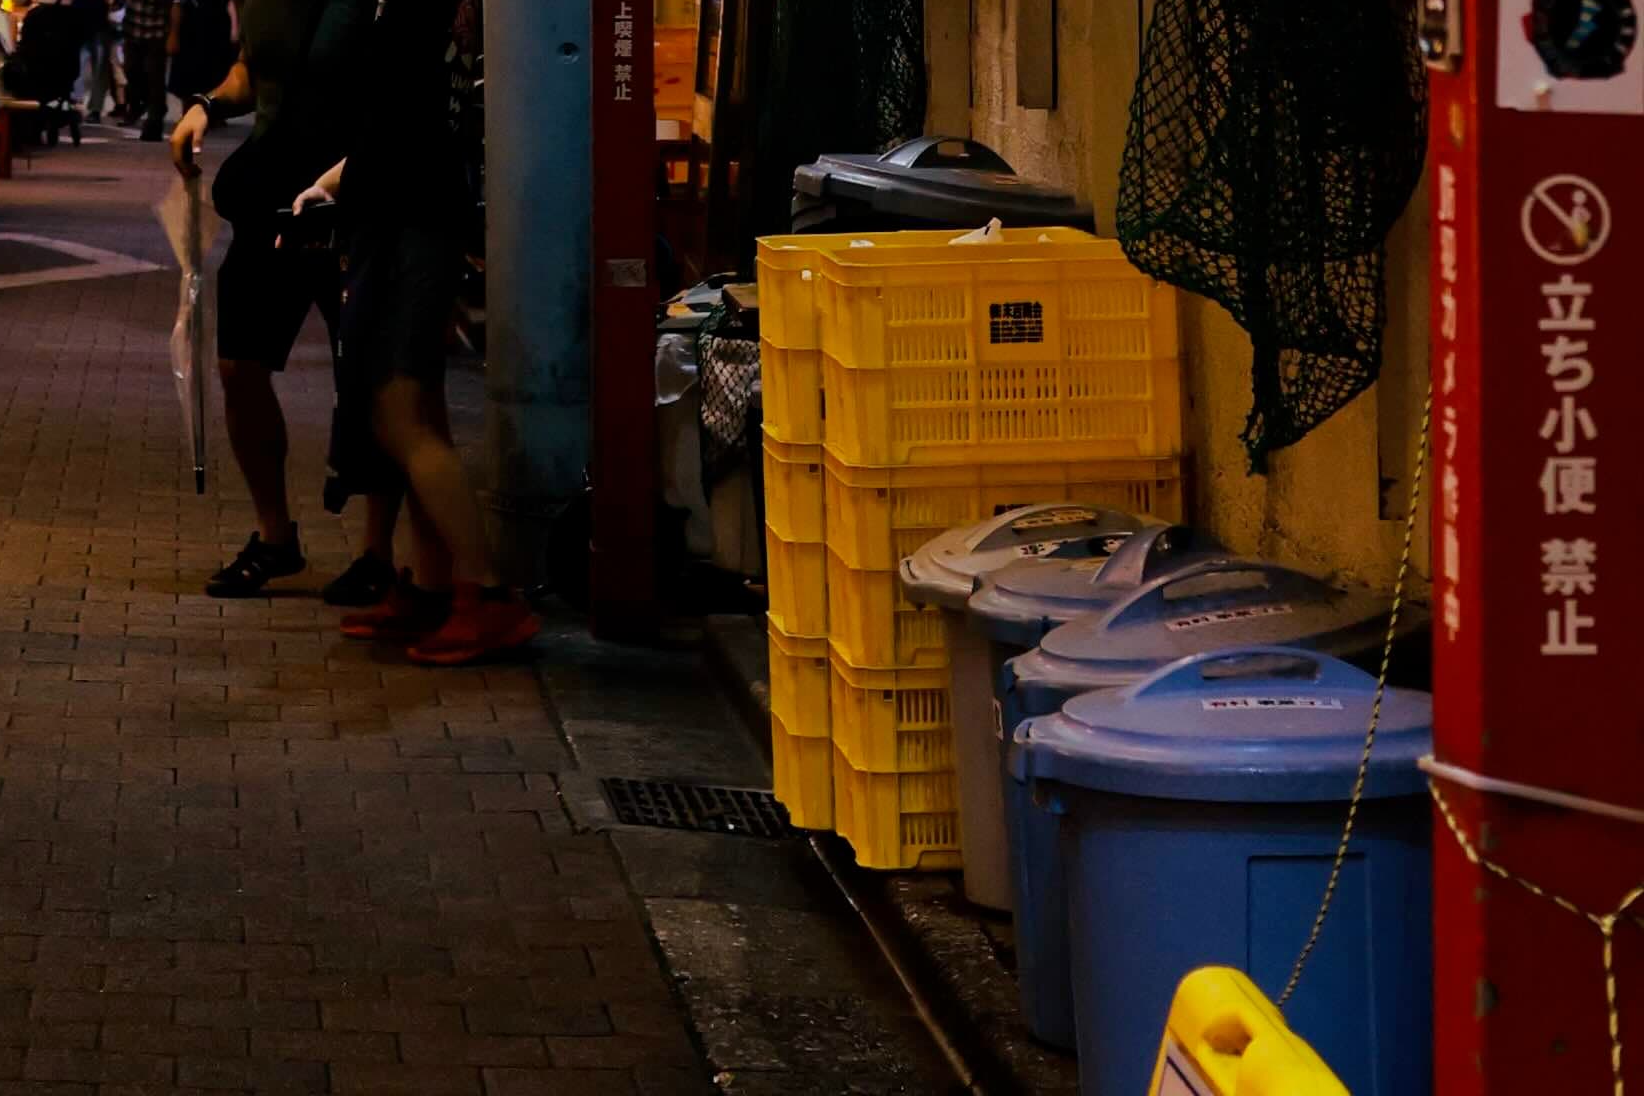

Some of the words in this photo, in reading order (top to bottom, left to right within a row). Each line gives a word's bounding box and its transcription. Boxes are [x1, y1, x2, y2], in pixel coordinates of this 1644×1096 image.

[613, 63, 633, 102] 禁止
[1537, 272, 1598, 516] 立ち小便
[1538, 536, 1599, 657] 禁止
